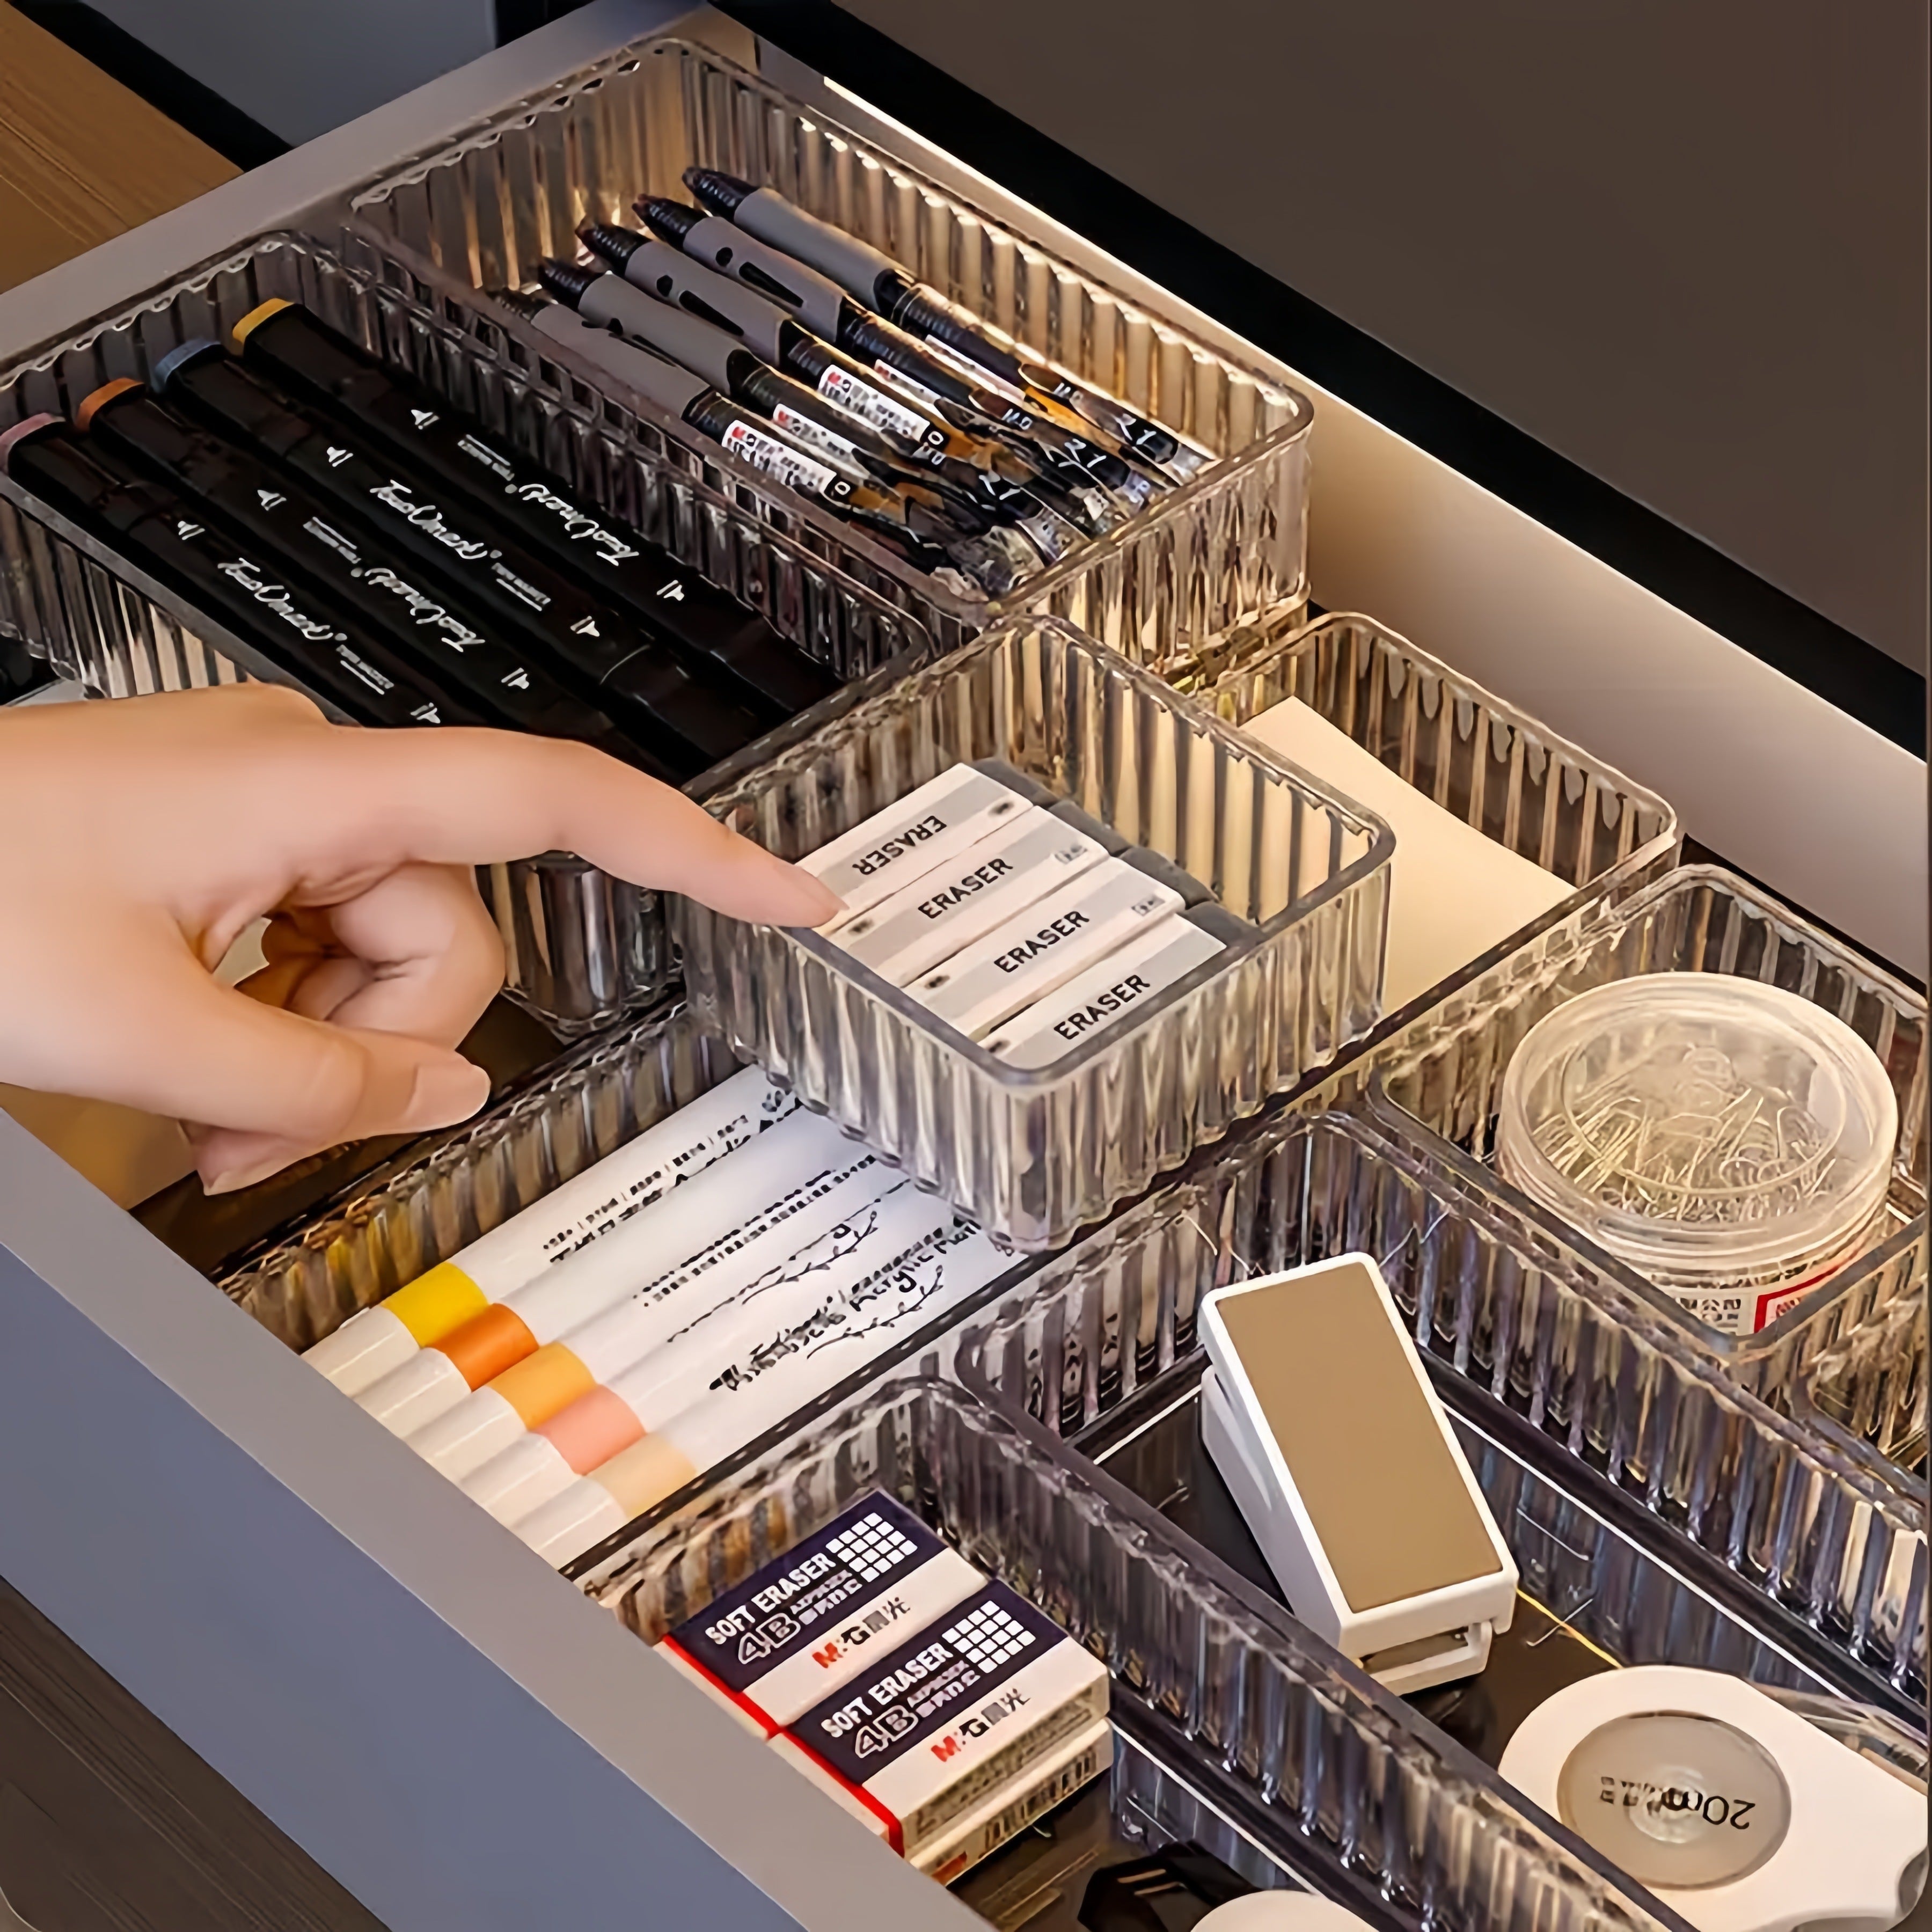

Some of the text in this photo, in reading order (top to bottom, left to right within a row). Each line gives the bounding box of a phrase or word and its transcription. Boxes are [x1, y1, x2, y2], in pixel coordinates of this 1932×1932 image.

[852, 815, 947, 875] ERASER
[918, 859, 1013, 919] ERASER
[994, 911, 1089, 972] ERASER
[1053, 975, 1150, 1040] ERASER
[705, 1605, 758, 1644] SOFT
[751, 1553, 836, 1611] ERASER
[737, 1613, 801, 1664] 4B
[821, 1697, 874, 1738] SOFT
[868, 1642, 953, 1702] ERASER
[854, 1705, 919, 1759] 4B
